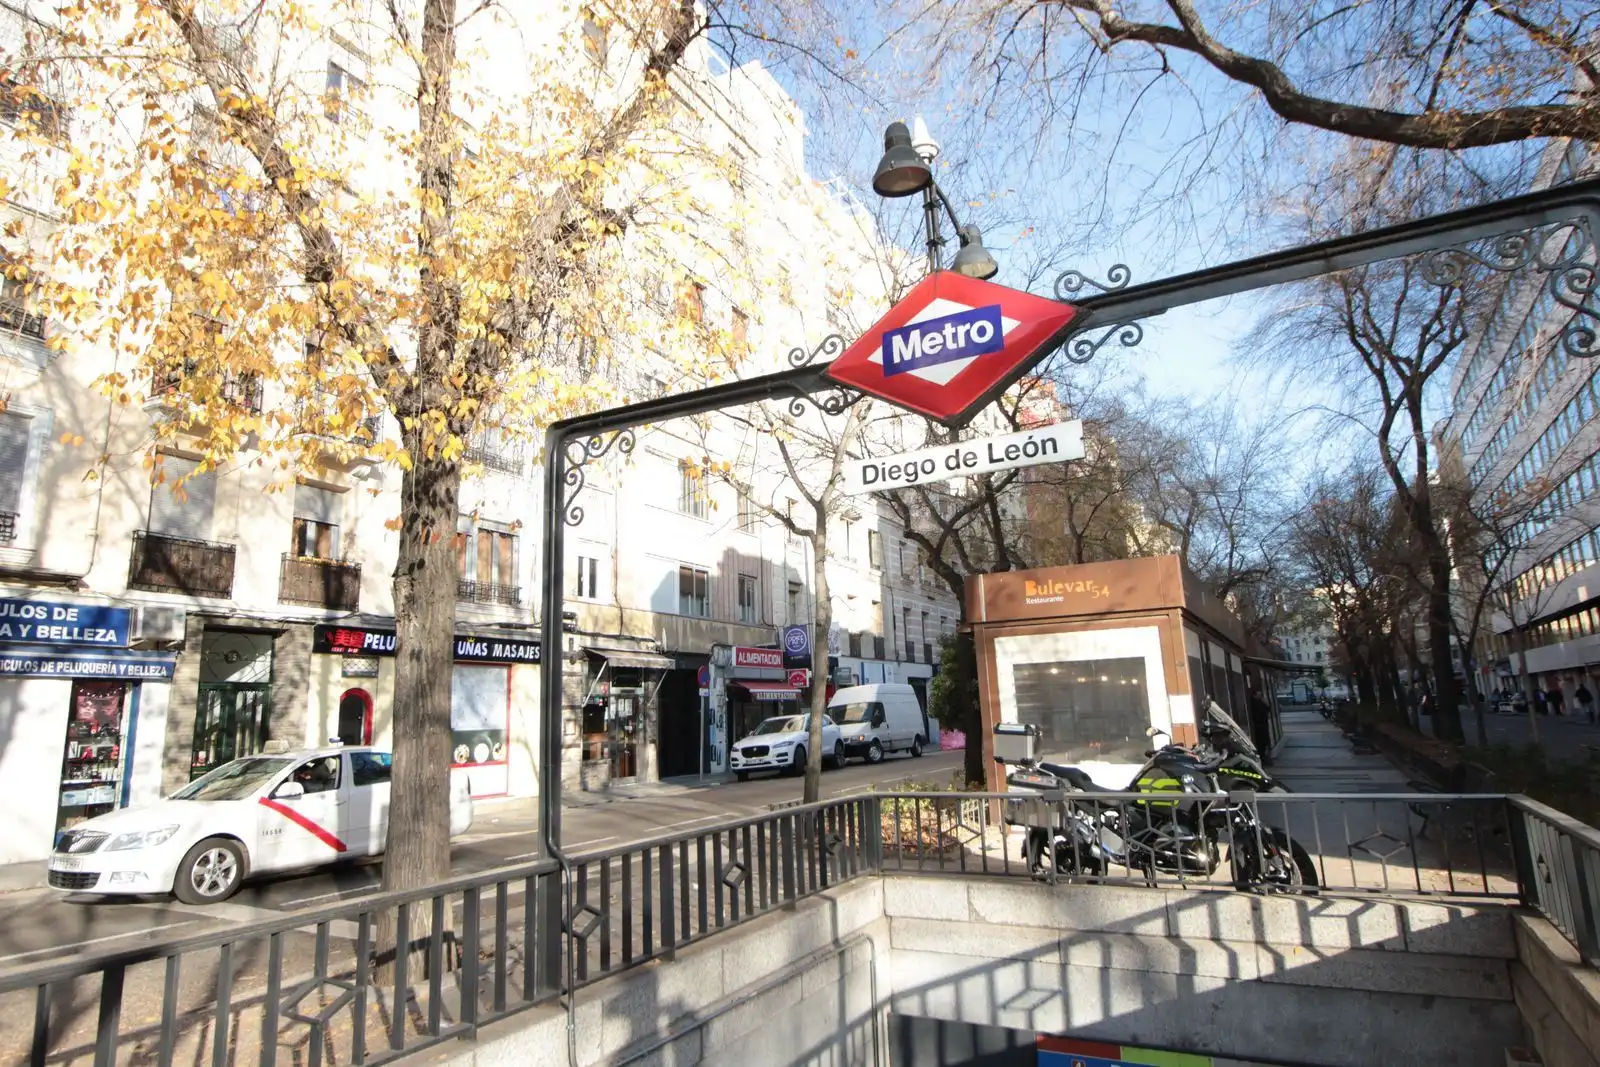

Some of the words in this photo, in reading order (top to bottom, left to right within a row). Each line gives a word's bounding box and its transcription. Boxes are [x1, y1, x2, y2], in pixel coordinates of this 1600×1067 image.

[892, 319, 994, 364] Metro
[862, 457, 936, 485] Diego
[944, 449, 978, 470] de
[988, 435, 1058, 464] León
[1025, 579, 1094, 597] Bulevar
[1091, 585, 1110, 599] 54
[1026, 596, 1064, 605] Restaurante
[52, 607, 79, 621] DE
[19, 624, 32, 638] Y
[36, 625, 118, 642] BELLEZA
[492, 643, 540, 659] MASAJES
[40, 661, 54, 673] DE
[56, 661, 117, 675] PELUQUERÍA
[120, 665, 128, 675] Y
[128, 665, 167, 676] BELLEZA
